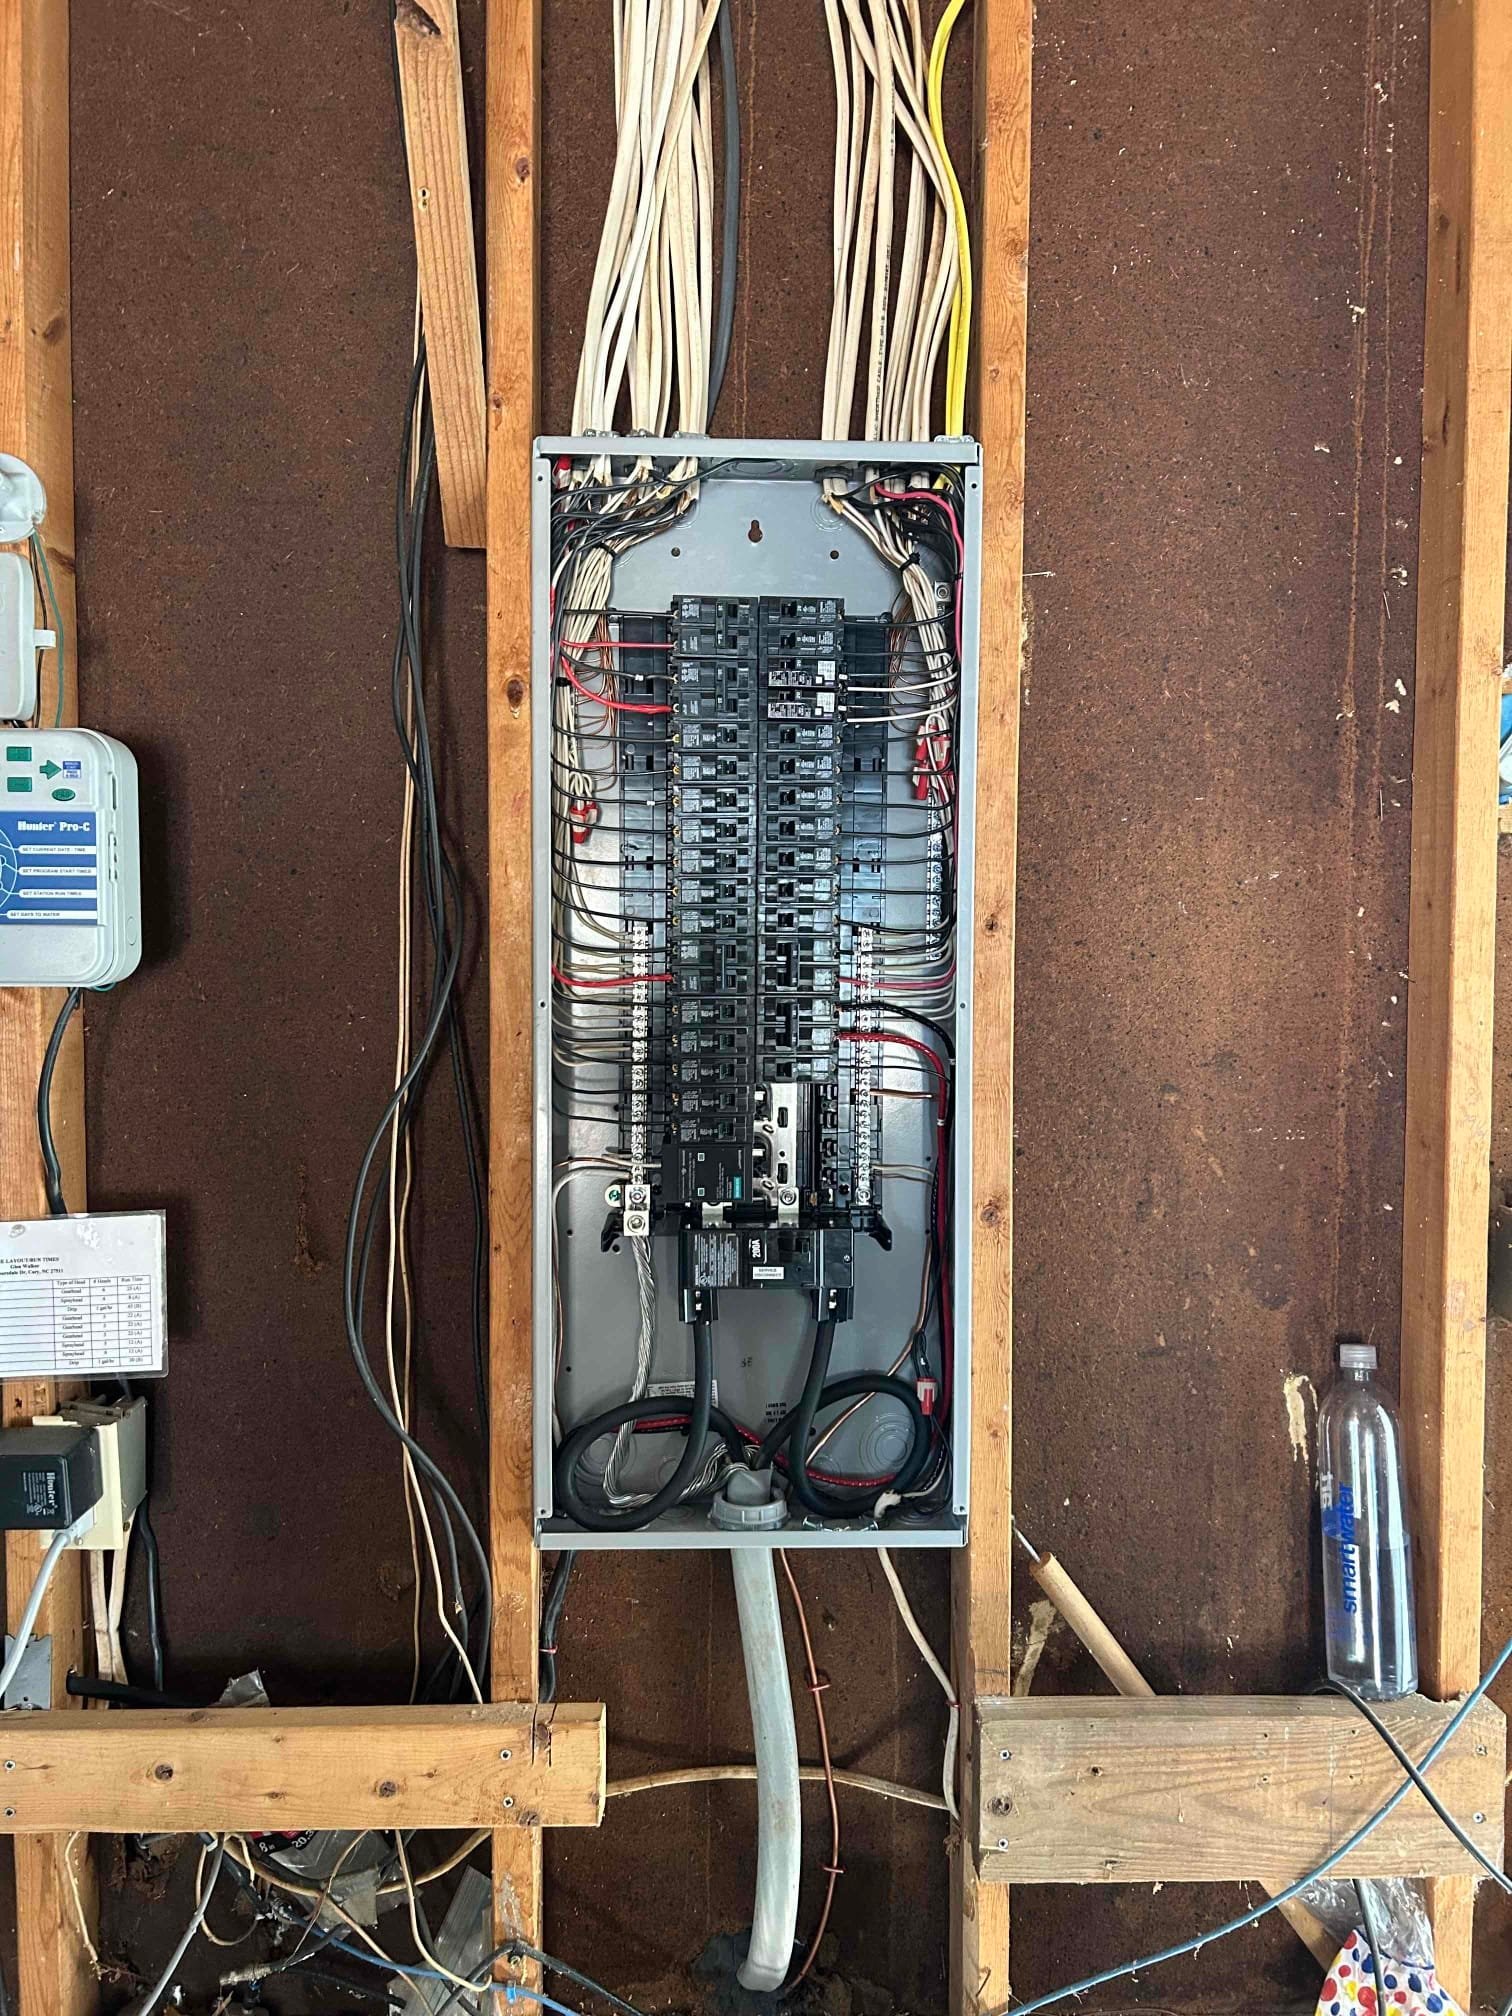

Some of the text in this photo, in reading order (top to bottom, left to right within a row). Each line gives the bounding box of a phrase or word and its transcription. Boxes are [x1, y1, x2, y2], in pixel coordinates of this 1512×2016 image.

[18, 820, 90, 831] Hunter Pro-C
[752, 1239, 761, 1258] 200A
[46, 1472, 56, 1505] Hunter
[1338, 1482, 1356, 1614] smartwater
[259, 1842, 268, 1852] 8
